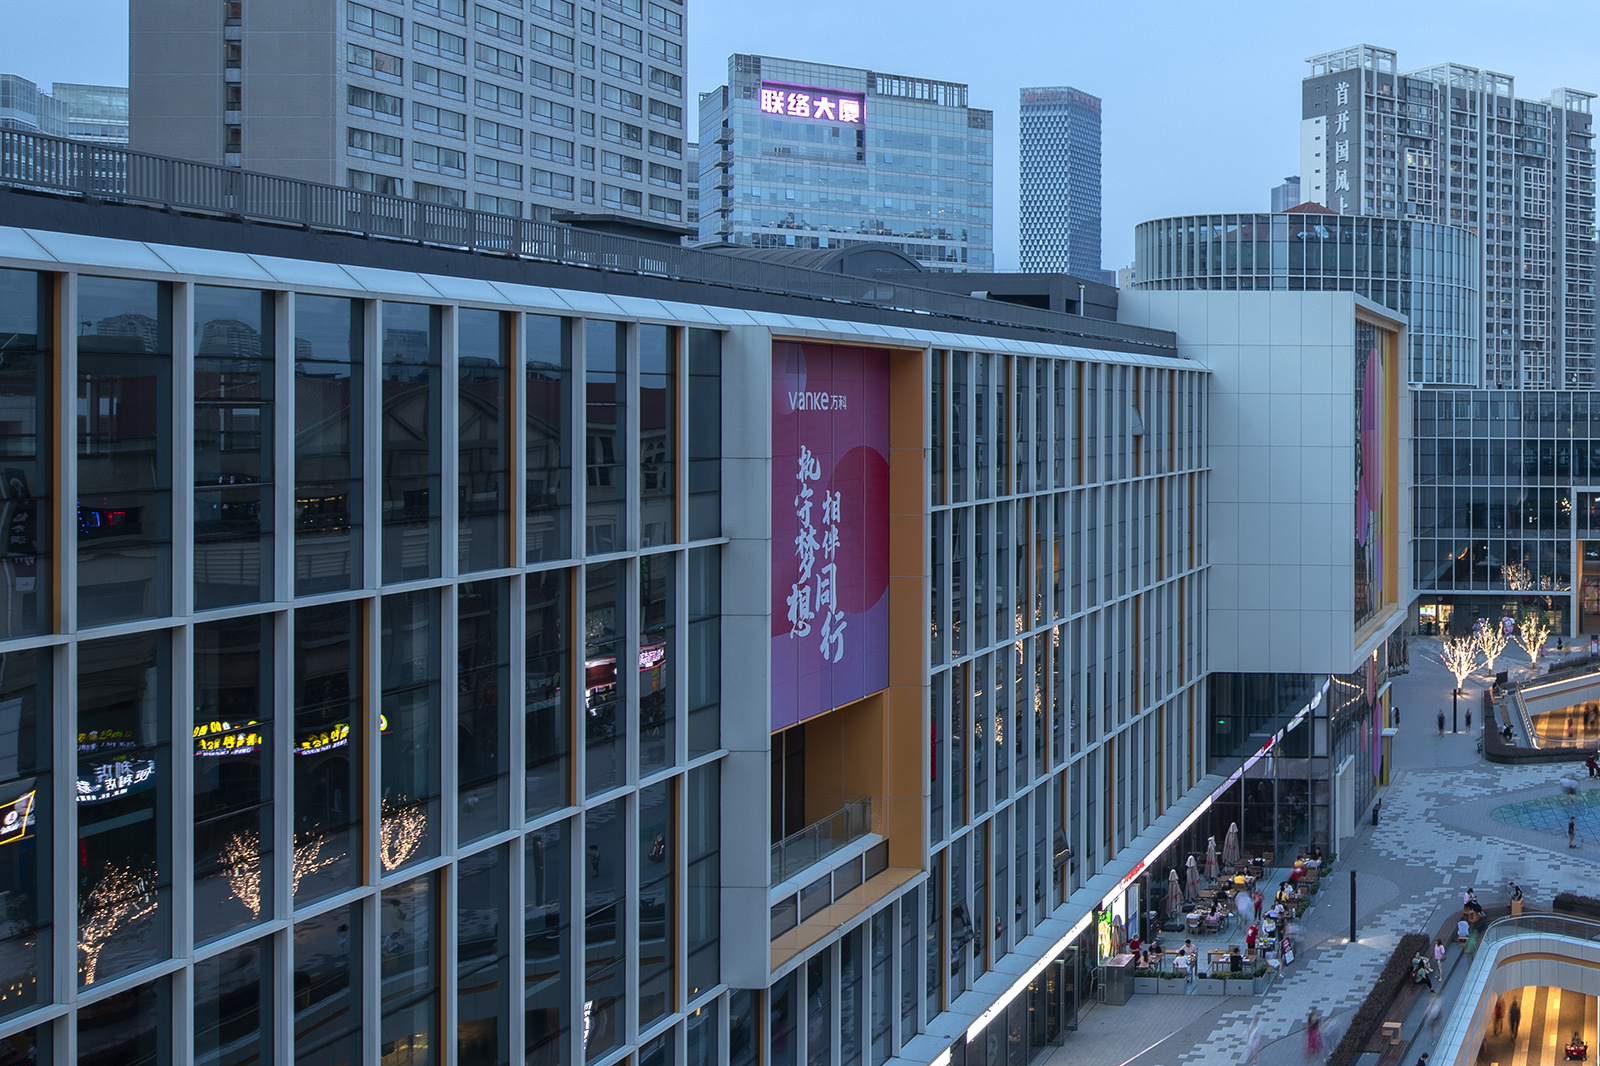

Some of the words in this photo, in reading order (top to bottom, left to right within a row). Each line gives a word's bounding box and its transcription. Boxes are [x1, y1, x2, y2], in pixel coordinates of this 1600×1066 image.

[761, 88, 860, 123] 联络大厦
[788, 389, 829, 411] vanke
[830, 395, 847, 411] 万科
[815, 489, 848, 664] 相伴同行
